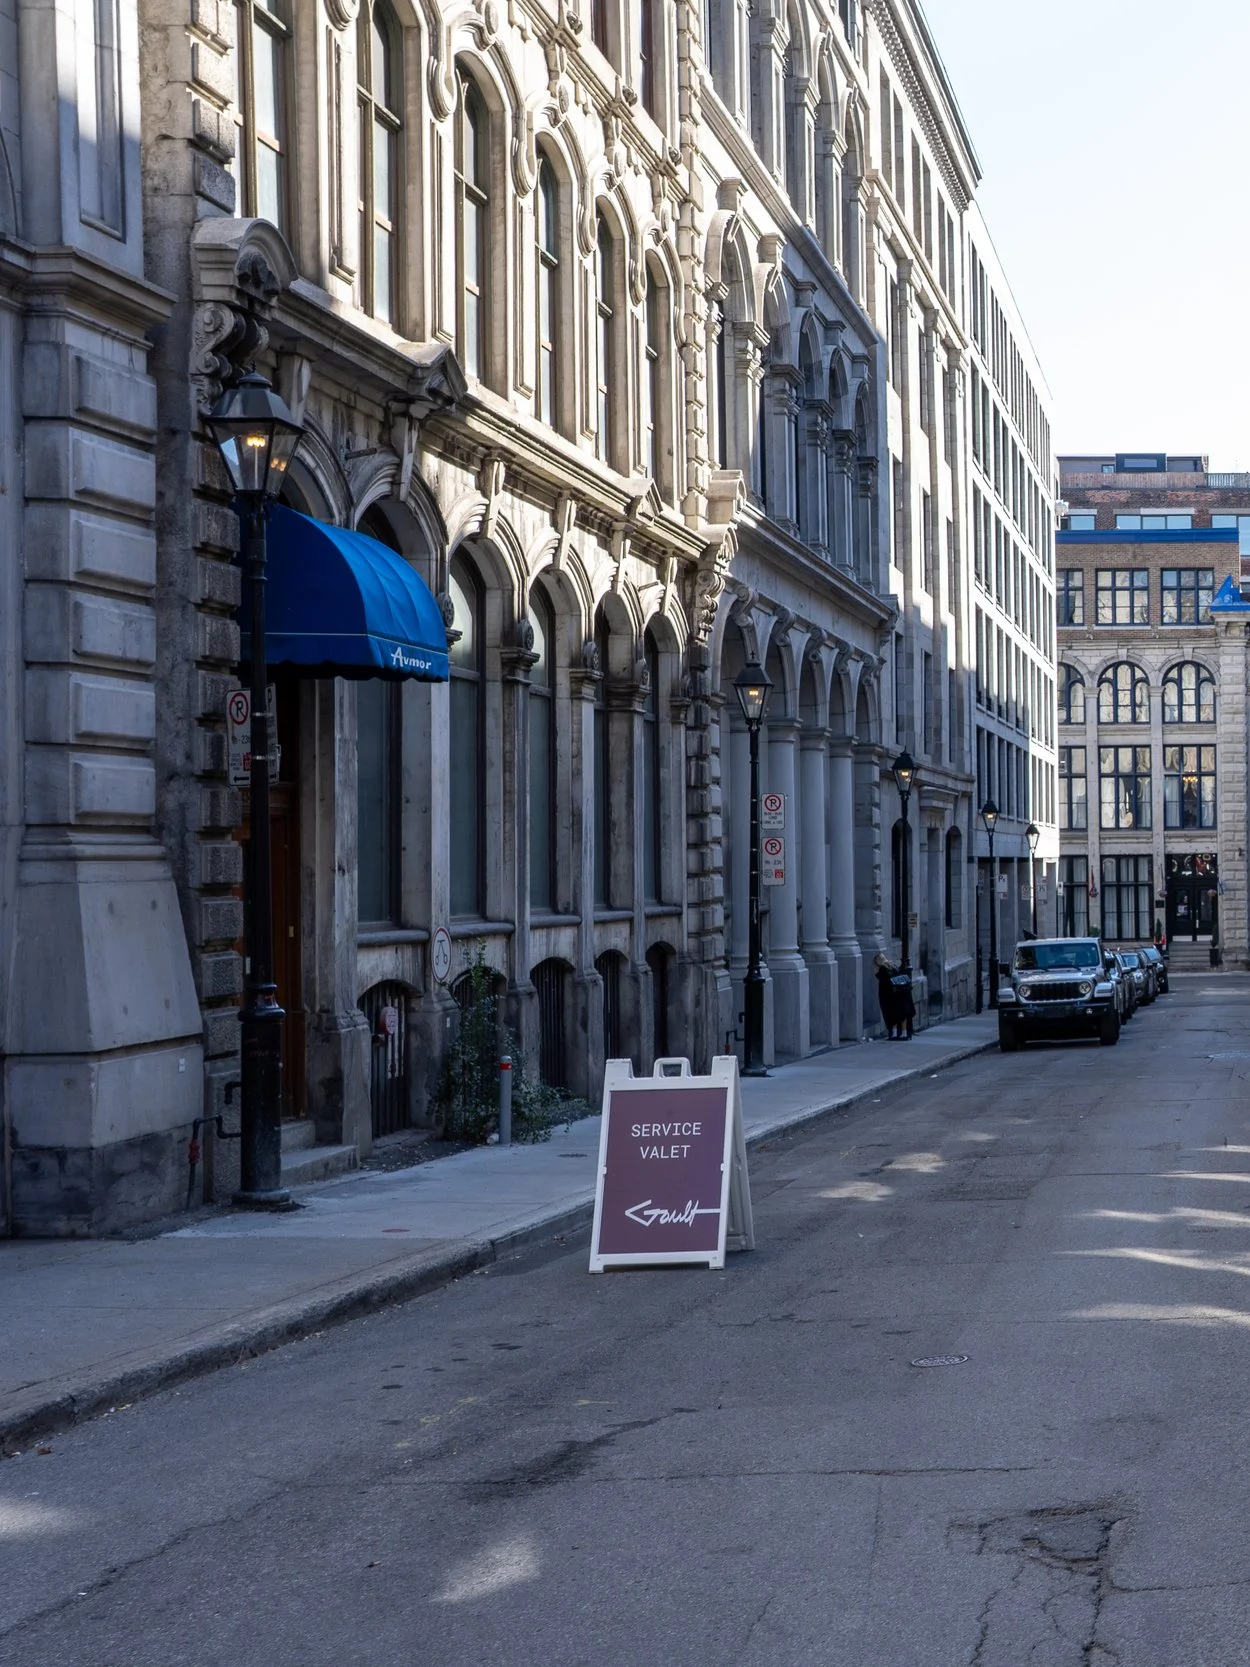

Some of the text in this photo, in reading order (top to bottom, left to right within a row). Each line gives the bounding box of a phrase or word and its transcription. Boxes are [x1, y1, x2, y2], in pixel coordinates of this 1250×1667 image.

[391, 647, 432, 669] Avmor
[631, 1122, 702, 1137] SERVICE
[640, 1145, 691, 1159] VALET
